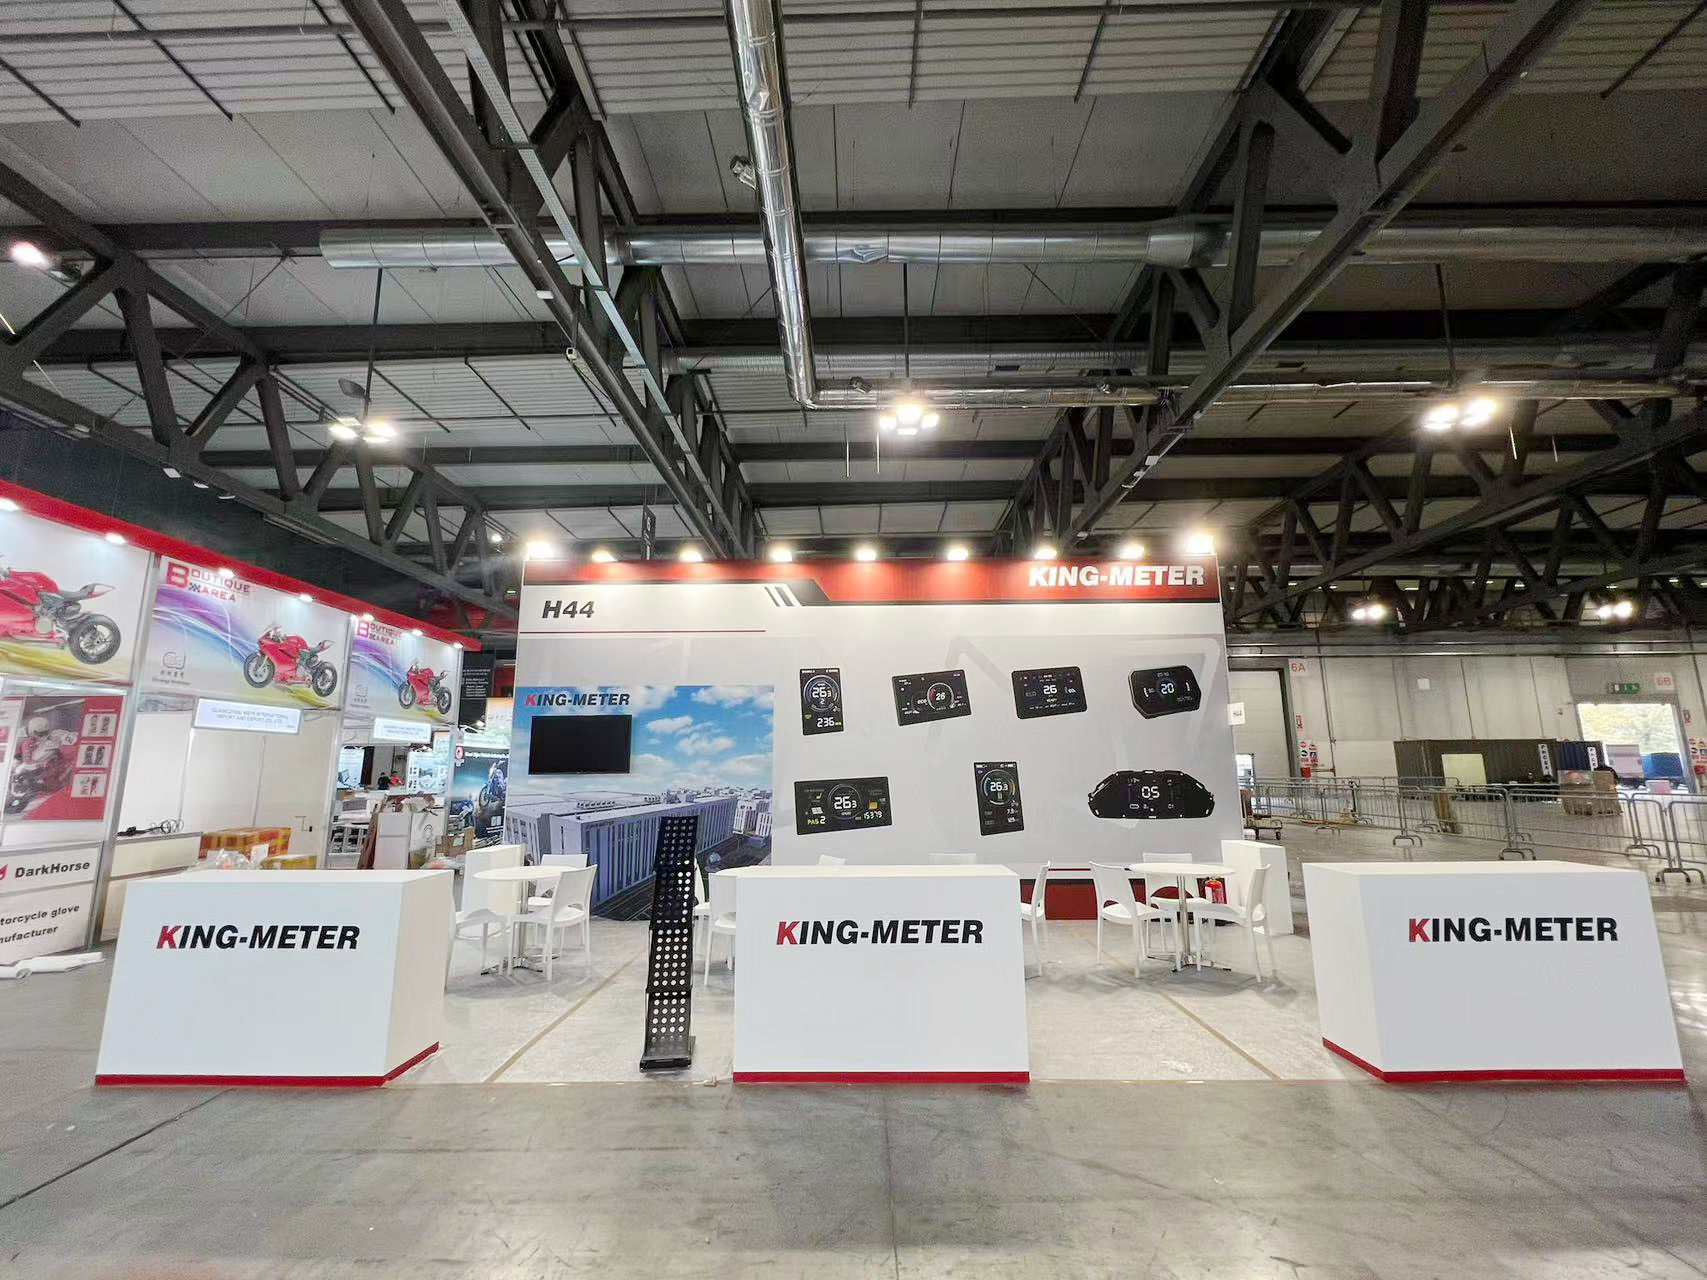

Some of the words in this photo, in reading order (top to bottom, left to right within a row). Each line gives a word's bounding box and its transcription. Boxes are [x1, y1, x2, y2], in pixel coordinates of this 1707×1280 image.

[167, 562, 250, 593] BOUTIQUE
[1028, 565, 1205, 587] KING-METER
[201, 586, 237, 603] AREA
[541, 600, 595, 619] H44
[1291, 663, 1306, 672] 6A
[1043, 684, 1058, 695] 26
[1161, 682, 1175, 695] 20
[525, 693, 631, 706] KING-METER
[935, 692, 946, 701] 26
[817, 717, 835, 728] 236
[1141, 786, 1159, 798] 05
[15, 862, 90, 878] DarkHorse
[50, 905, 80, 918] glove
[773, 919, 984, 945] KING-METER
[1408, 917, 1618, 942] KING-METER
[156, 924, 361, 950] KING-METER
